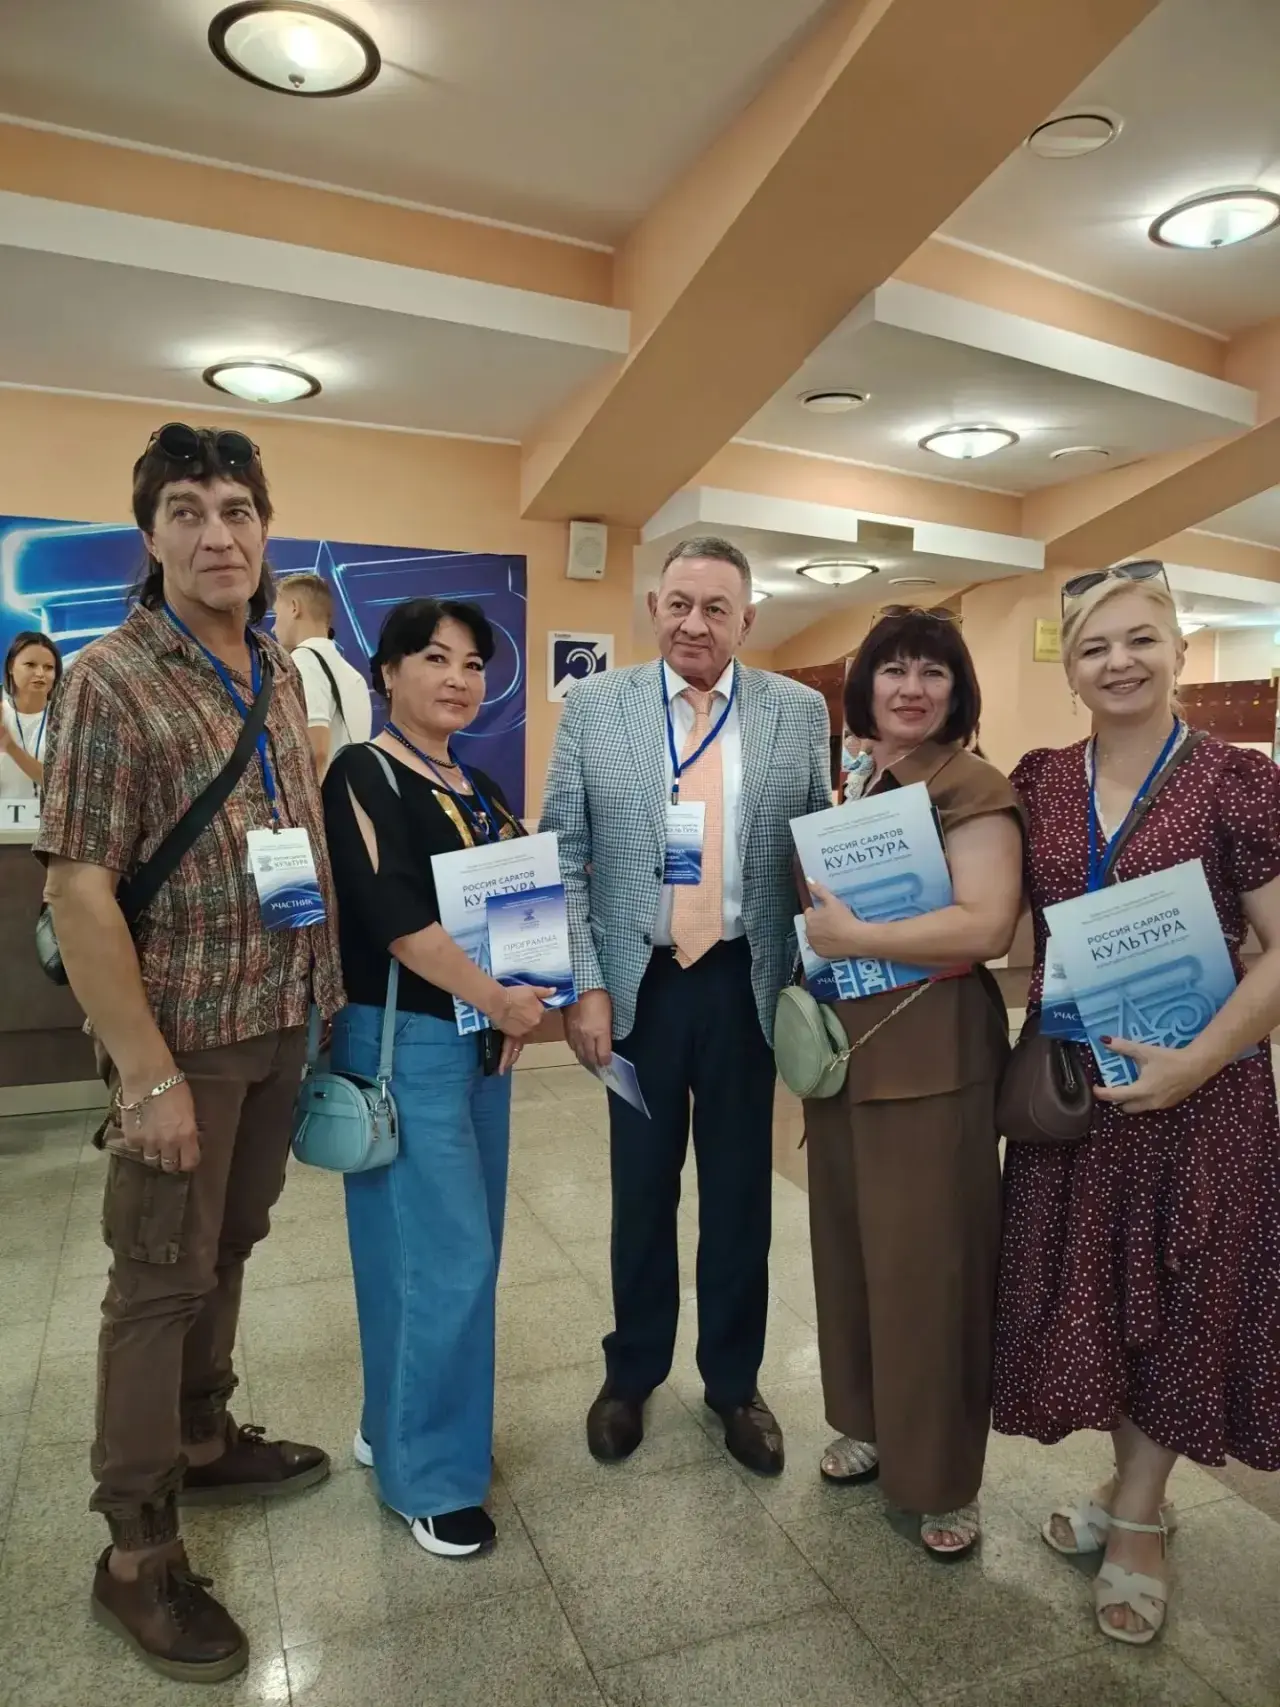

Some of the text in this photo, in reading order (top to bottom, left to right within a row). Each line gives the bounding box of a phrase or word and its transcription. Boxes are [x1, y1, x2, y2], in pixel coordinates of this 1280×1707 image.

[821, 828, 904, 856] РОССИЯ САРАТОВ
[824, 839, 911, 871] КУЛЬТУРА
[462, 870, 535, 892] РОССИЯ САРАТОВ
[271, 899, 313, 909] УЧАСТНИК
[1087, 908, 1180, 945] РОССИЯ САРАТОВ
[1091, 920, 1187, 961] КУЛЬТУРА
[503, 934, 557, 951] ПРОГРАММА
